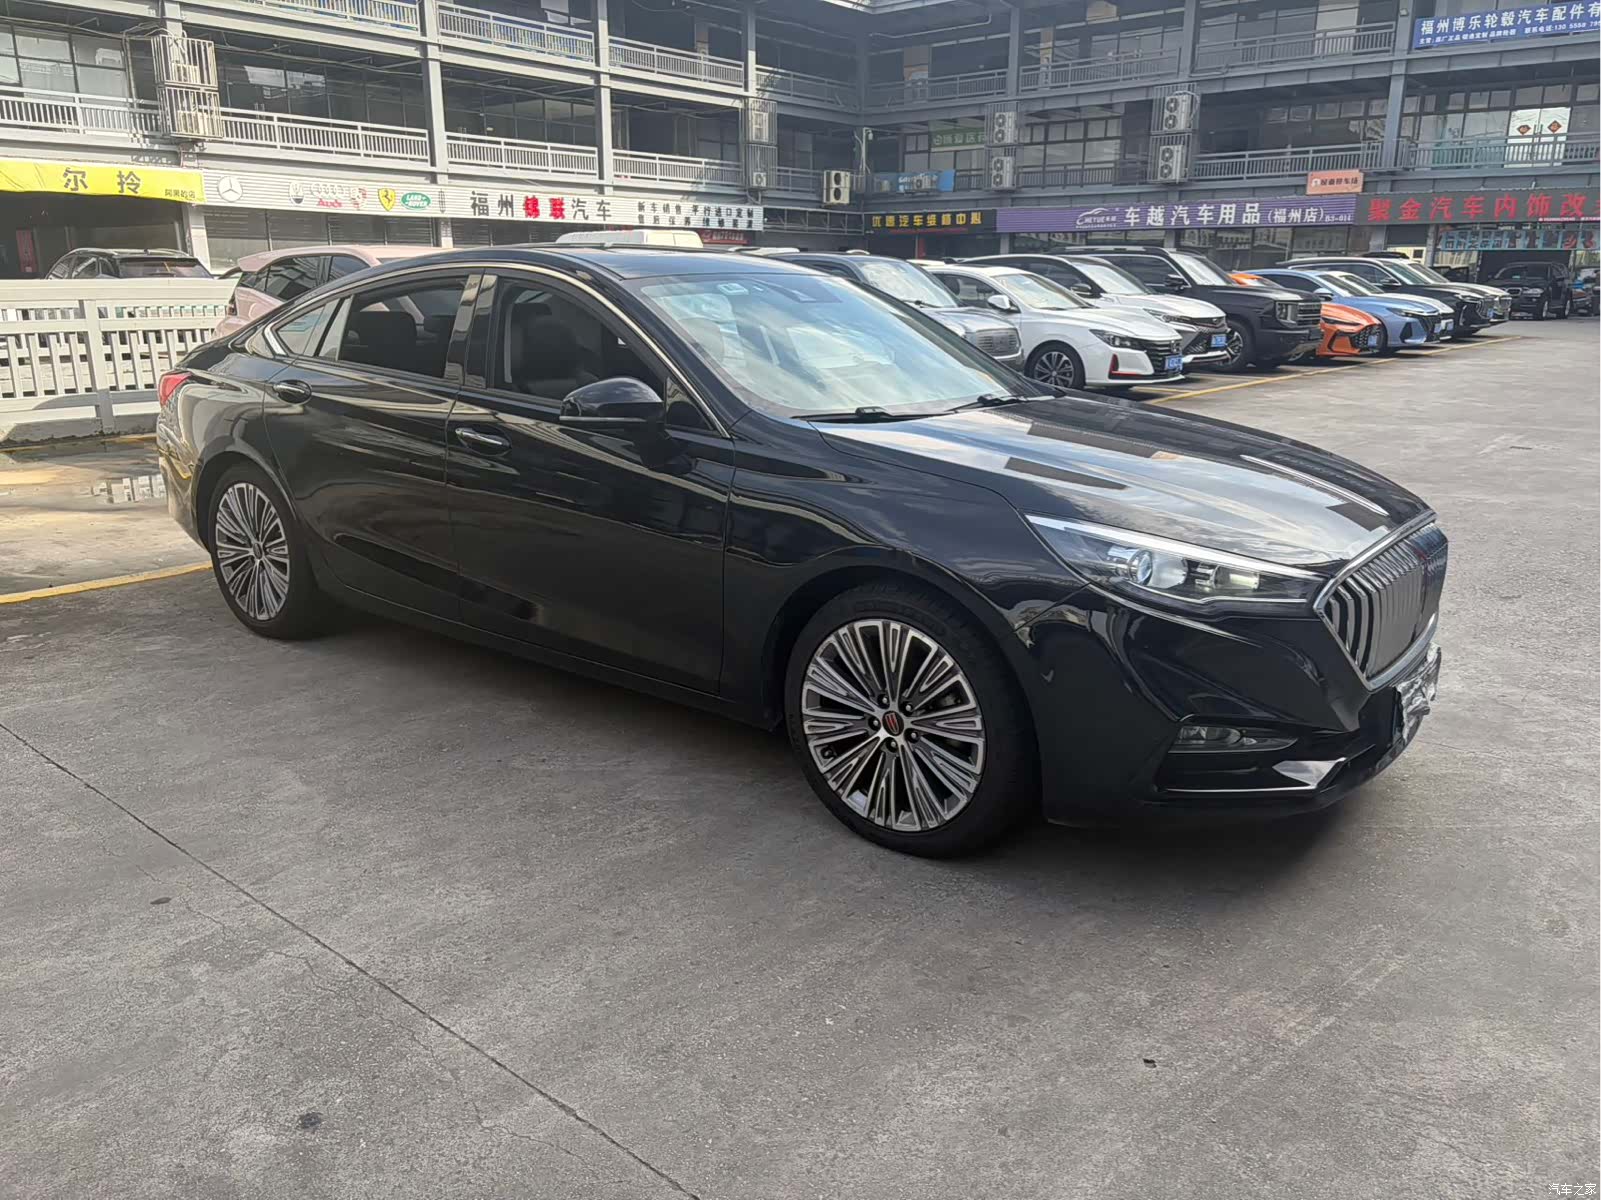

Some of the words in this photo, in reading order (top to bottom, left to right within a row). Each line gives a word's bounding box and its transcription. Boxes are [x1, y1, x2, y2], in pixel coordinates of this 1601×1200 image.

[1123, 203, 1260, 227] 车越汽车用品
